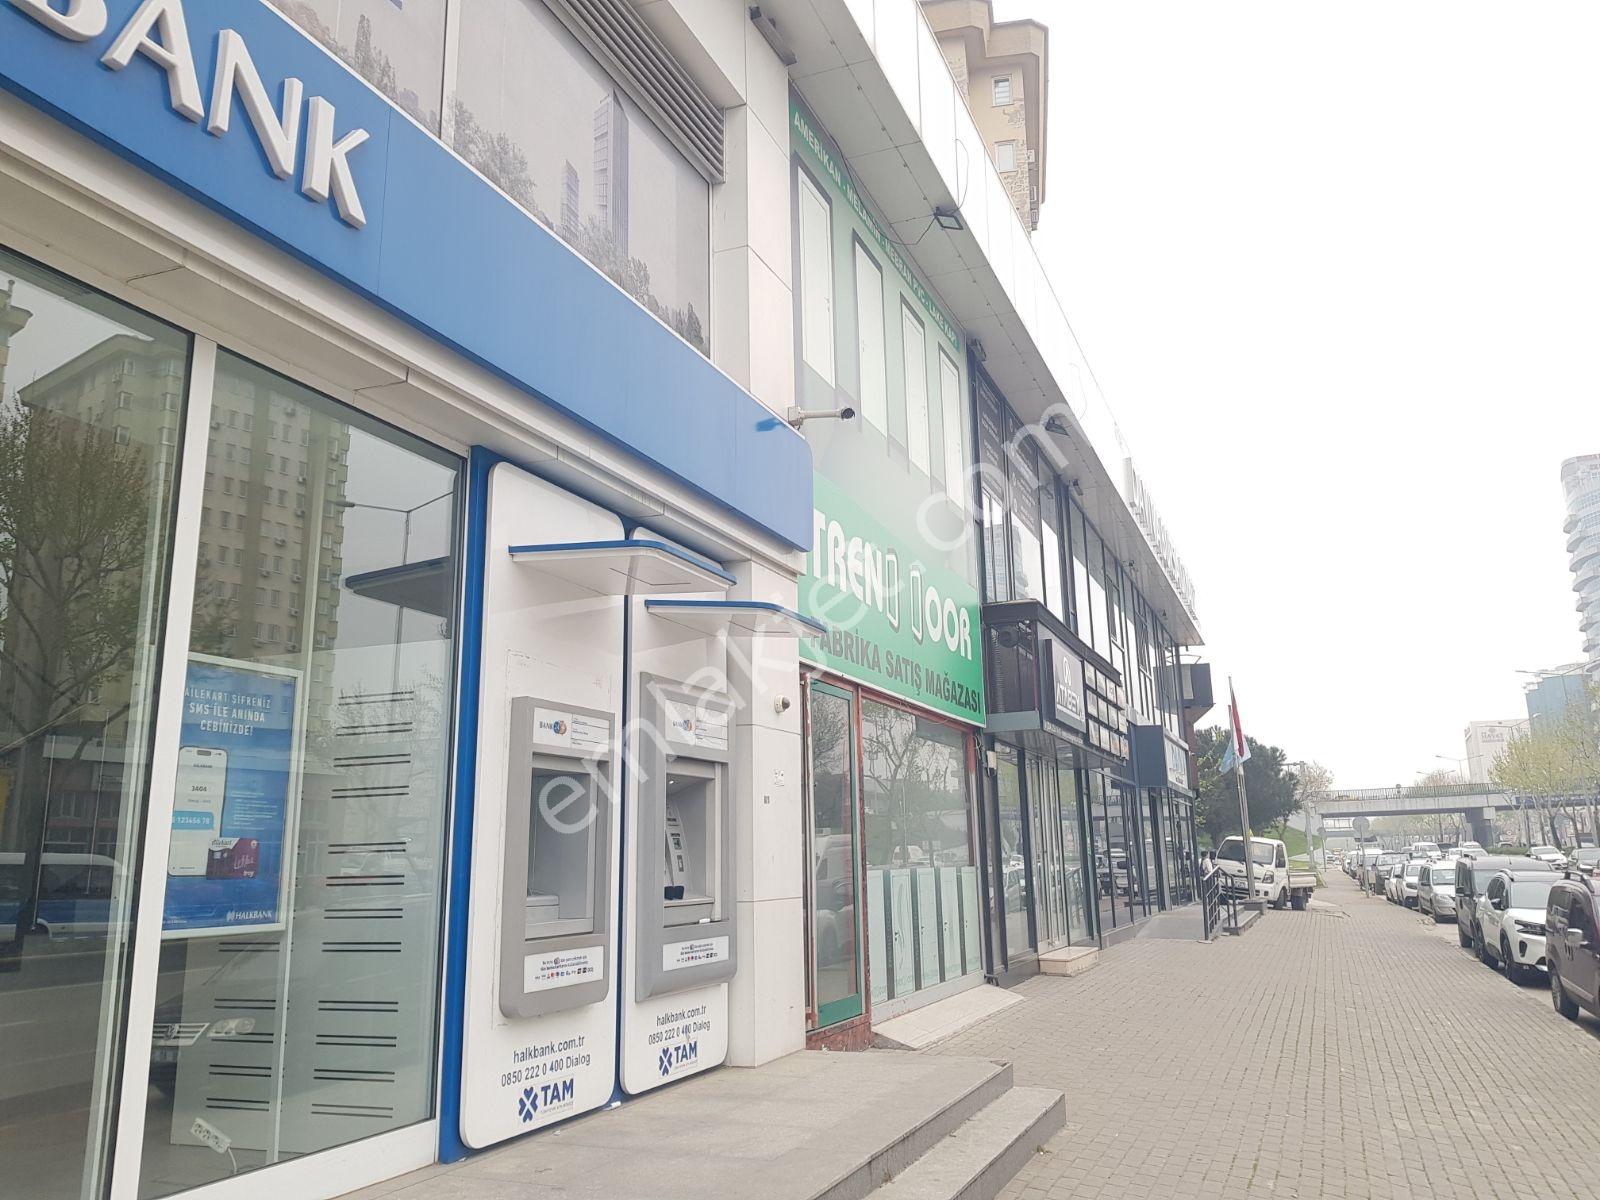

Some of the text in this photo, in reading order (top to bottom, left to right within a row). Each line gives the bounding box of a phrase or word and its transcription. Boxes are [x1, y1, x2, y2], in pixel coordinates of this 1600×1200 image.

[794, 111, 841, 187] AMERİKAN
[885, 650, 922, 696] SATIŞ
[925, 667, 981, 714] MAĞAZASI
[189, 702, 265, 722] SMS İLE ANINDA
[235, 910, 273, 921] HALKBANK
[656, 1005, 707, 1027] halkbank.com.tr
[648, 1020, 711, 1045] 0850 222 0 400 Dialog
[513, 1035, 585, 1064] halkbank.com.tr
[674, 1040, 698, 1064] TAM
[501, 1053, 591, 1087] 0850 222 0 400 Dialog
[540, 1078, 574, 1107] TAM
